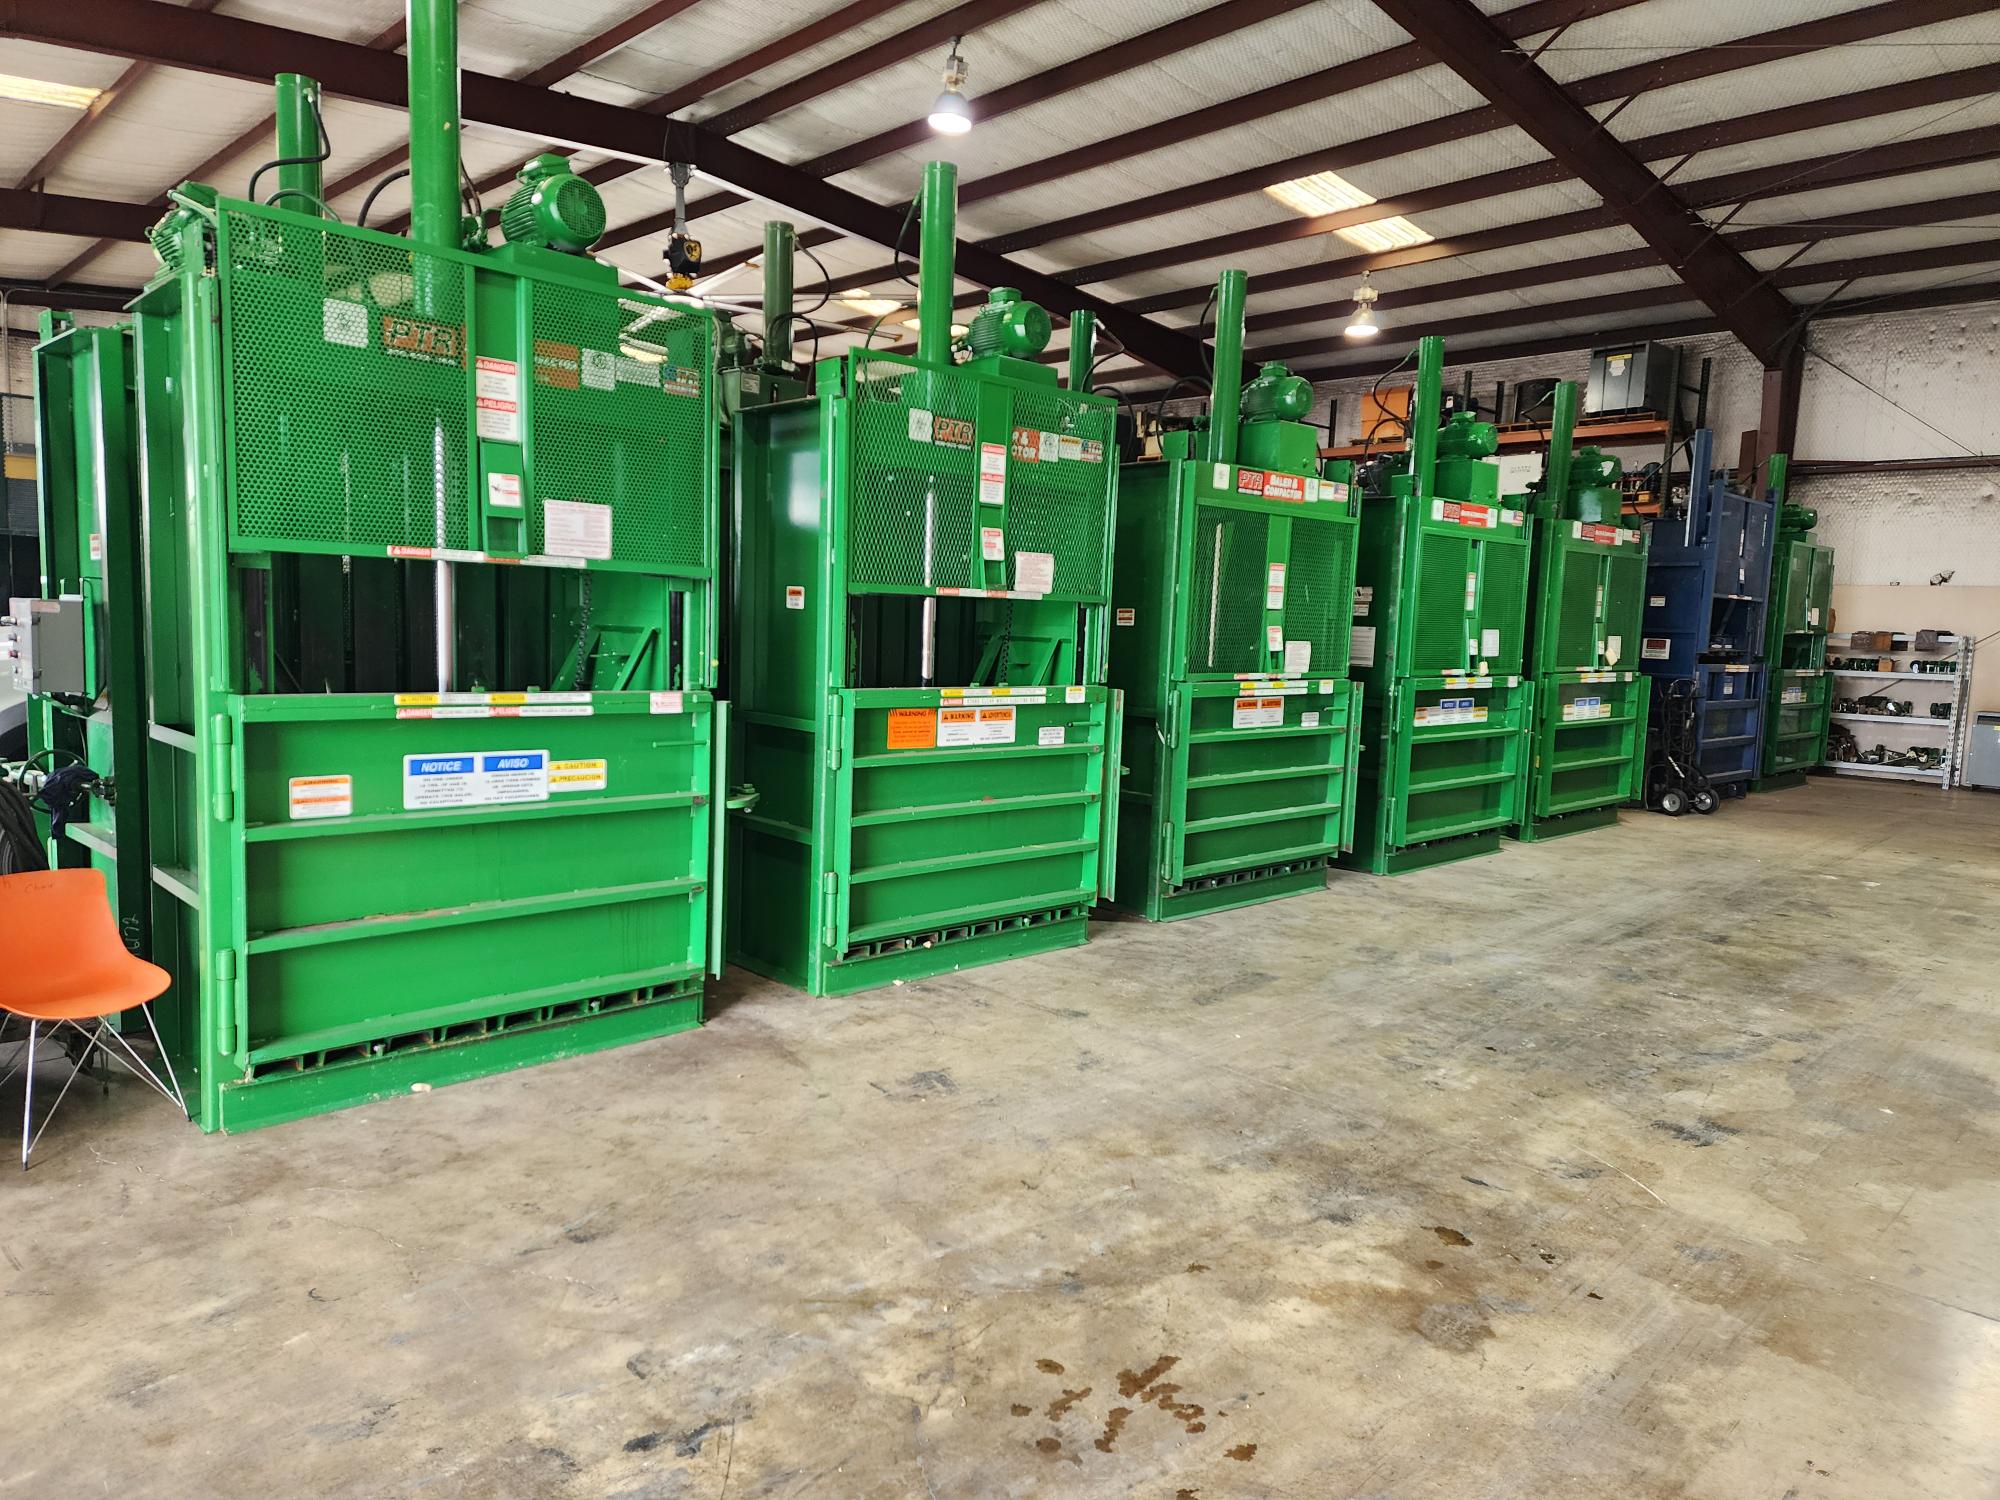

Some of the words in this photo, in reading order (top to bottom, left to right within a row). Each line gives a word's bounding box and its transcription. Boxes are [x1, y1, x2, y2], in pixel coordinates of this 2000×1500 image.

[387, 318, 458, 356] PTR
[484, 361, 516, 374] DANGER
[484, 399, 517, 412] PELIGRO
[939, 420, 974, 444] PTR
[1241, 472, 1263, 489] PTR
[1263, 484, 1302, 500] COMPACTOR
[421, 761, 462, 772] NOTICE
[497, 758, 530, 769] AVISO
